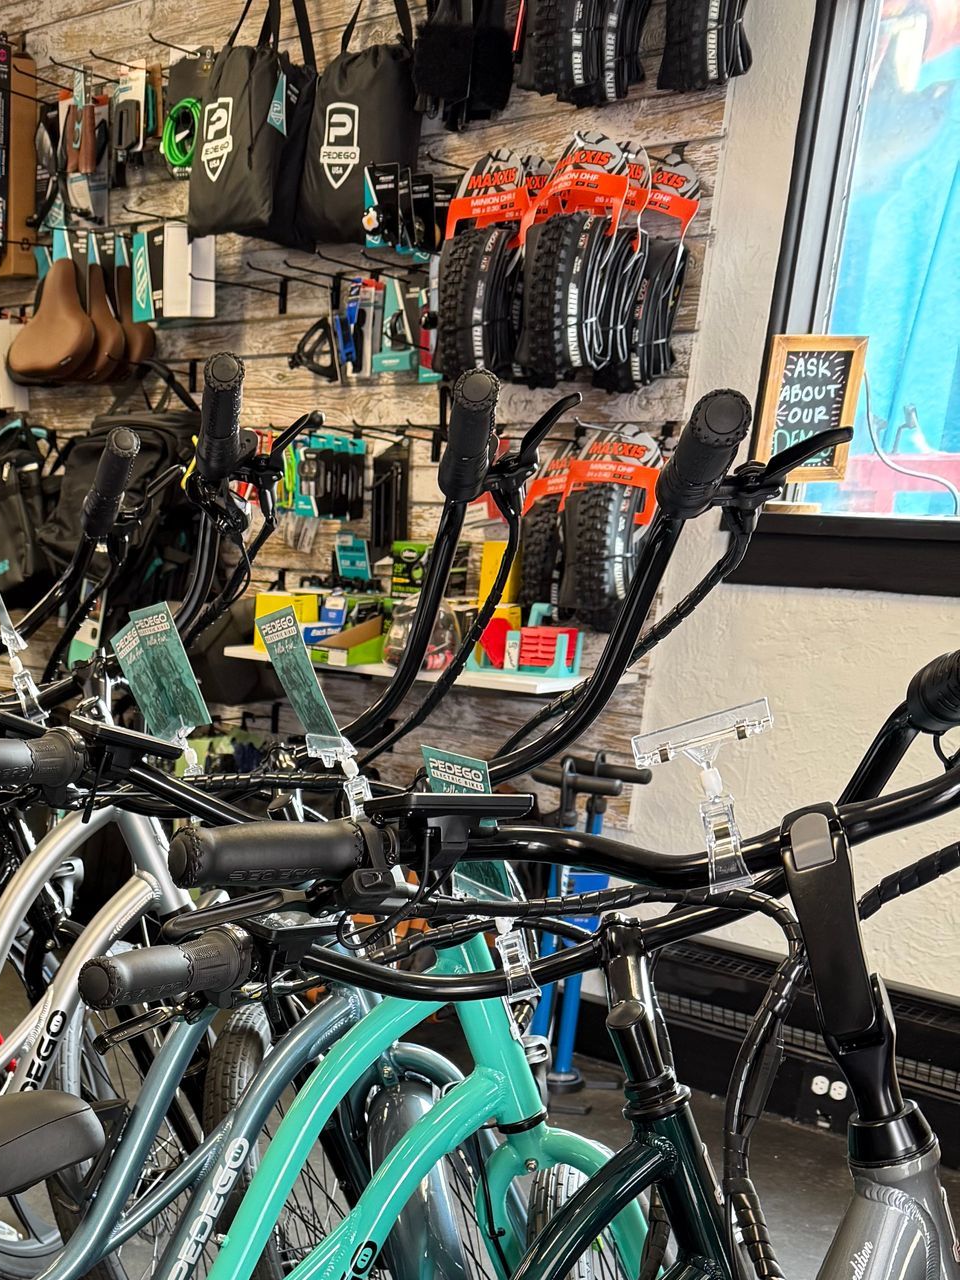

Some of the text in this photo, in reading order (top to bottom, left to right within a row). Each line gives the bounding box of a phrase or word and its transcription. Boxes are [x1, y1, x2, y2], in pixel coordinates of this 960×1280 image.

[322, 151, 357, 160] PEDEGO
[468, 167, 518, 190] MAXXIS
[471, 195, 499, 207] MINION
[794, 357, 831, 378] ASK
[780, 384, 842, 403] ABOUT
[788, 406, 829, 424] OUR
[590, 442, 647, 459] MAXXIS
[134, 613, 167, 629] PEDEGO
[261, 615, 294, 636] PEDEGO
[429, 758, 483, 782] PEDEGO
[432, 769, 484, 792] ELECTRIC BIKES
